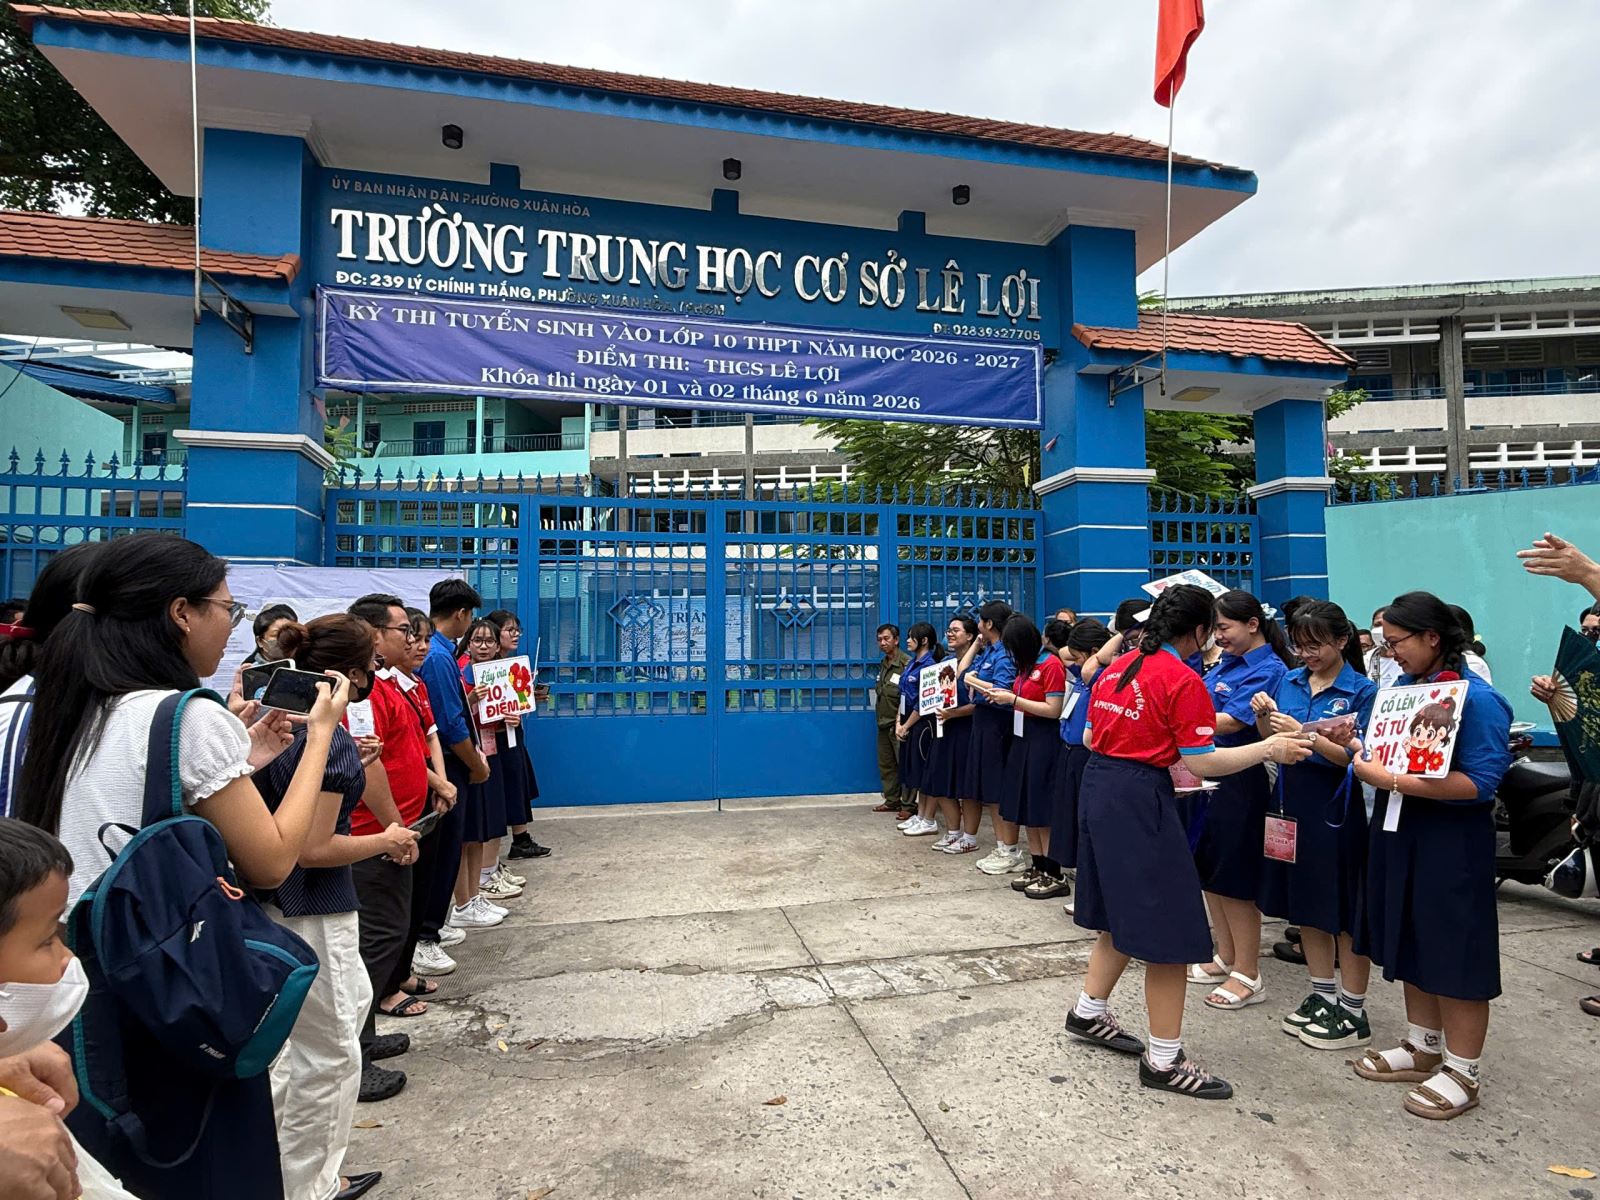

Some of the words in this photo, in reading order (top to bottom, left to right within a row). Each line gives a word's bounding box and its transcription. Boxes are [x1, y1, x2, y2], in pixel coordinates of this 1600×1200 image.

[332, 174, 351, 190] ỦY
[354, 182, 383, 194] BAN
[386, 184, 427, 199] NHÂN
[430, 188, 459, 203] DÂN
[463, 192, 520, 209] PHƯỜNG
[523, 200, 560, 213] XUÂN
[562, 201, 590, 217] HÒA
[331, 203, 528, 274] TRƯỜNG
[538, 229, 690, 290] TRUNG
[696, 245, 782, 304] HỌC
[794, 252, 850, 303] CƠ
[859, 249, 908, 309] SỞ
[915, 259, 965, 313] LÊ
[976, 268, 1041, 324] LỢI
[336, 270, 367, 286] ĐC:
[370, 273, 404, 288] 239
[407, 273, 423, 290] LÝ
[425, 276, 475, 294] CHÍNH
[479, 280, 536, 301] THẮNG,
[348, 301, 384, 321] KỲ
[392, 307, 436, 326] THI
[444, 309, 530, 333] TUYỂN
[536, 319, 595, 338] SINH
[601, 321, 652, 343] VÀO
[659, 326, 704, 346] LỚP
[713, 334, 737, 348] 10
[743, 336, 802, 354] THPT
[808, 339, 856, 358] NĂM
[861, 345, 906, 363] HỌC
[911, 349, 958, 365] 2026
[975, 353, 1021, 369] 2027
[953, 323, 1041, 341] 02839327705
[576, 343, 637, 368] ĐIỂM
[643, 354, 690, 371] THI:
[703, 358, 764, 376] THCS
[770, 360, 799, 379] LÊ
[804, 365, 841, 385] LỢI
[481, 367, 540, 386] Khóa
[546, 371, 577, 388] thi
[583, 374, 637, 395] ngày
[643, 379, 669, 394] 01
[678, 379, 703, 396] và
[709, 383, 735, 398] 02
[742, 384, 800, 406] tháng
[805, 390, 818, 404] 6
[824, 389, 867, 407] năm
[872, 394, 921, 410] 2026
[487, 685, 502, 702] 10
[1380, 693, 1398, 714] CỐ
[1396, 693, 1416, 711] LÊN
[1374, 717, 1390, 738] SĨ
